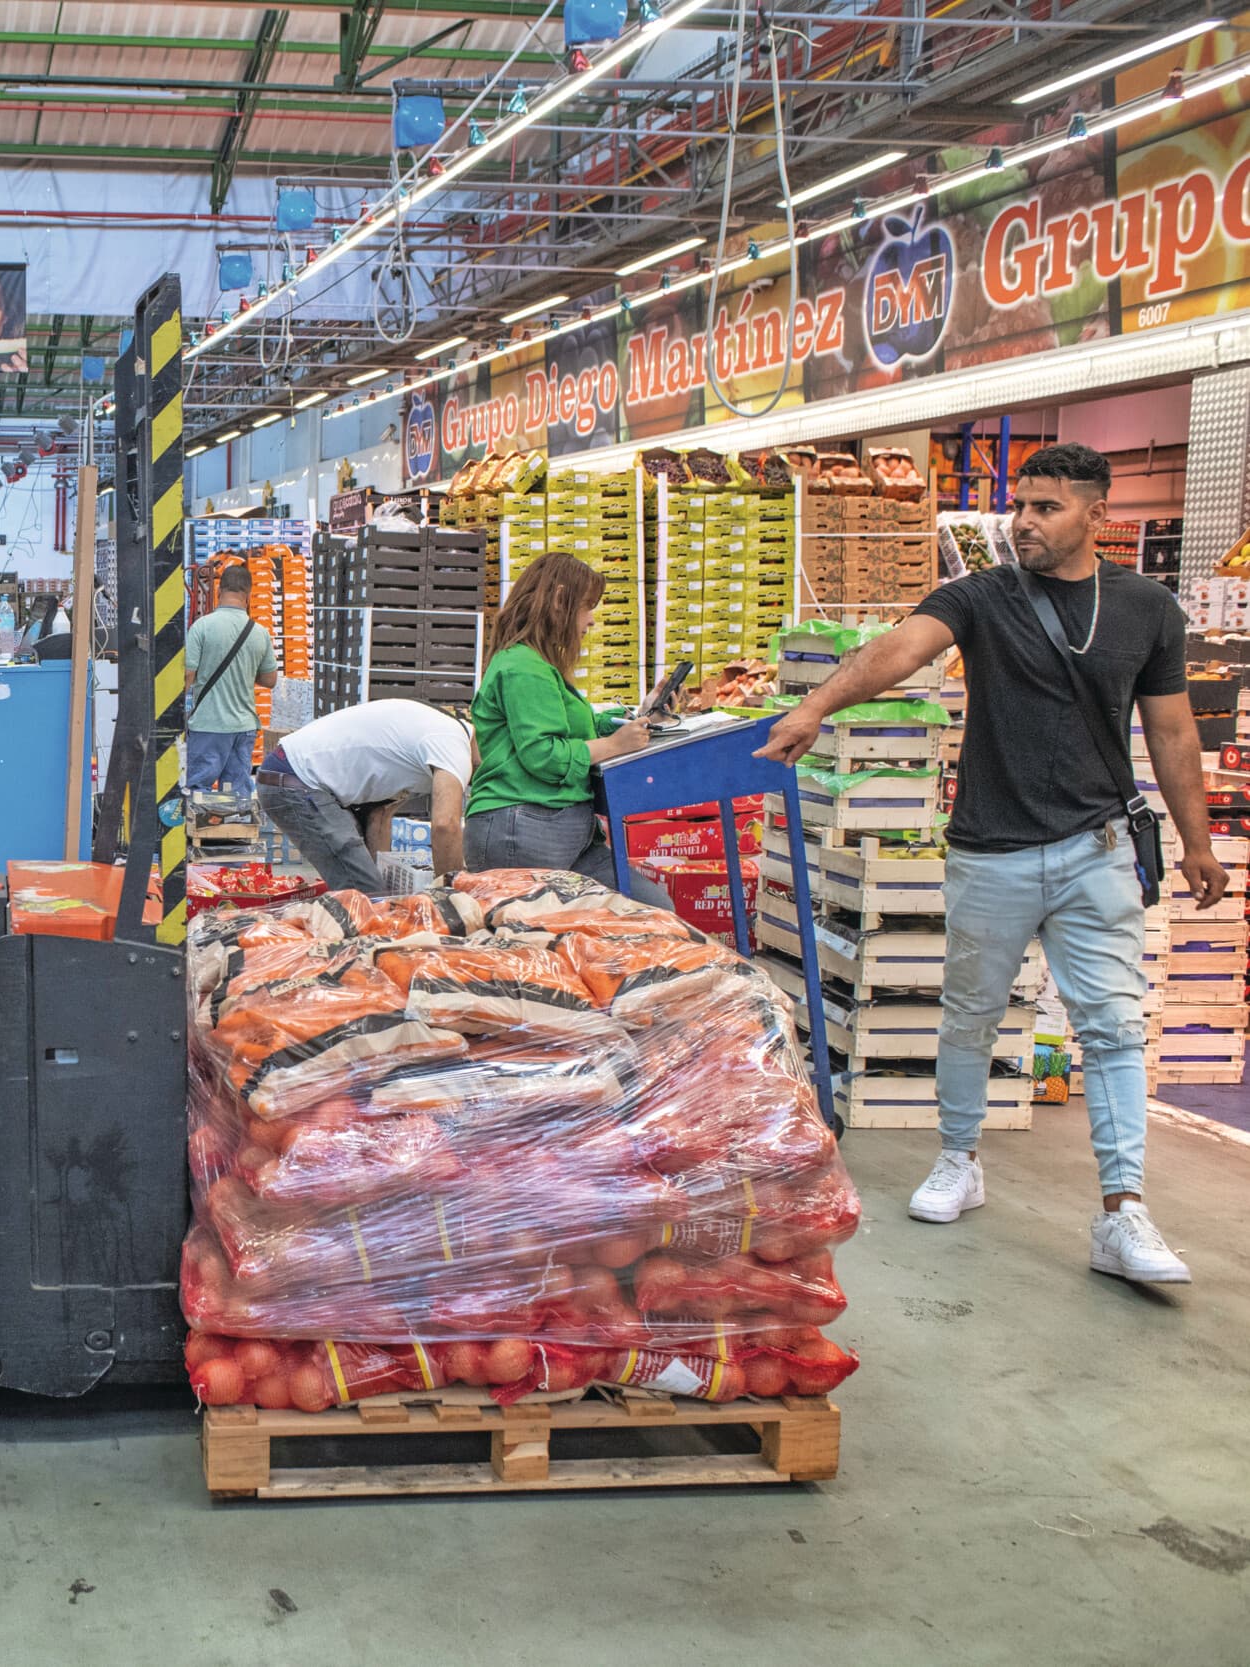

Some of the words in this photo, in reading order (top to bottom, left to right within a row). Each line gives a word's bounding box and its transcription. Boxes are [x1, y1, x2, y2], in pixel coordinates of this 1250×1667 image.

[1138, 303, 1171, 328] 6007
[441, 393, 519, 455] Grupo
[524, 360, 618, 436] Diego
[626, 288, 846, 406] Martínez
[649, 849, 668, 857] RED
[670, 845, 708, 857] POMELO
[694, 901, 714, 910] RED
